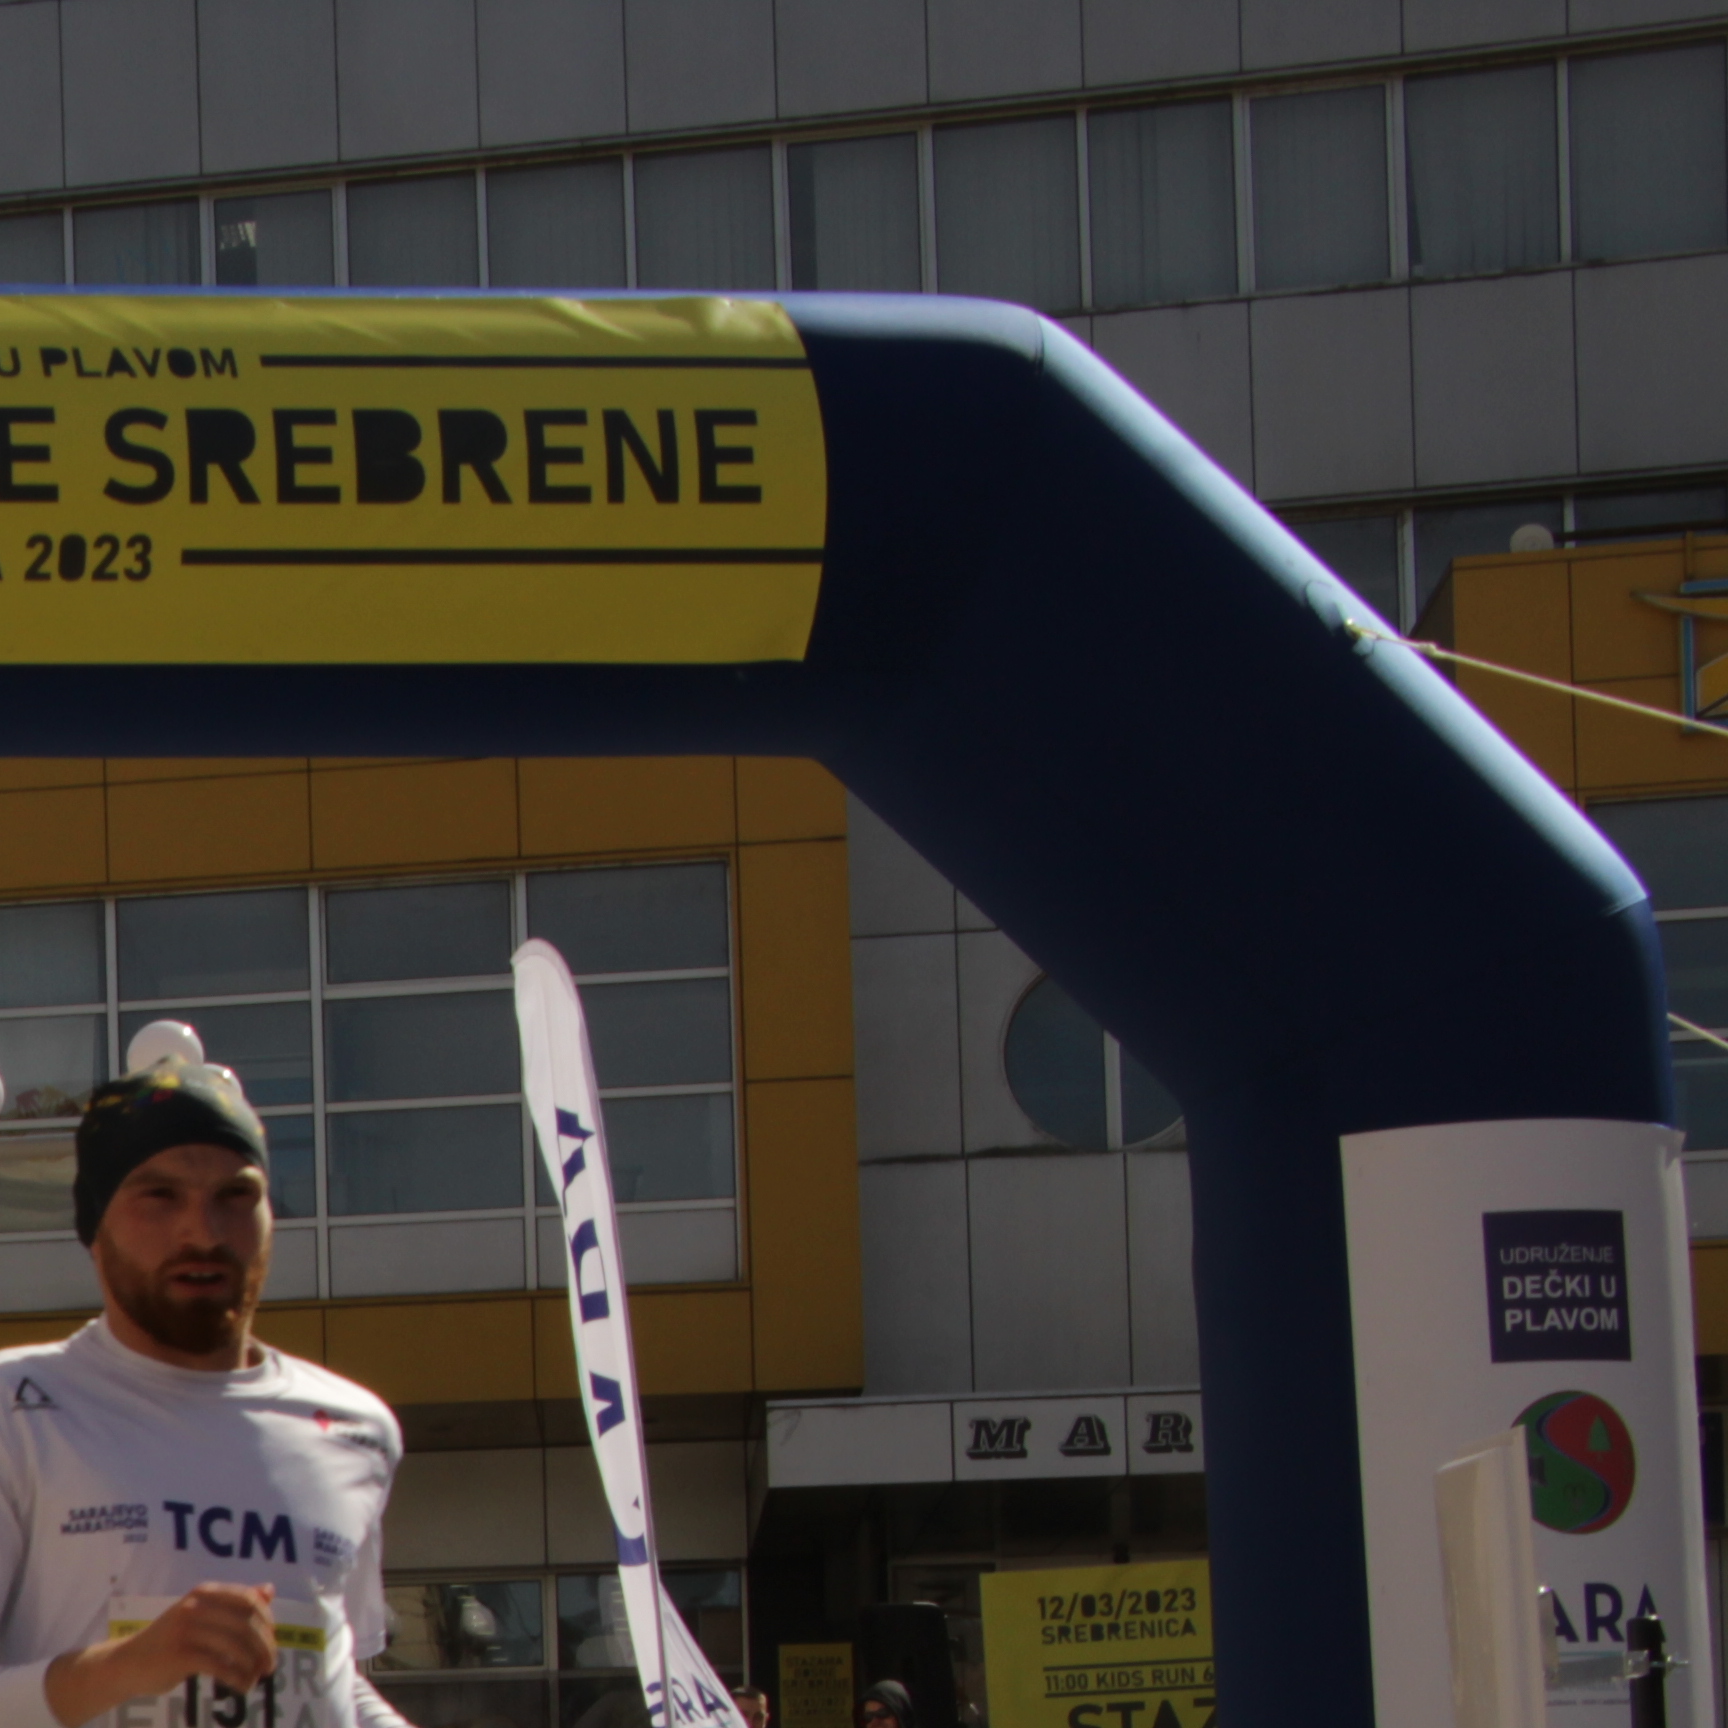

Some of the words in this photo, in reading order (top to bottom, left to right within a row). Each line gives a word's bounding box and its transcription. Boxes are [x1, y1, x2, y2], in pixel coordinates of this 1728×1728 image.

[39, 346, 239, 379] PLAVOM
[102, 406, 762, 506] SREBRENE
[24, 533, 154, 583] 2023
[1499, 1241, 1615, 1265] UDRUŽENJE
[1503, 1268, 1590, 1299] DEČKI
[1600, 1275, 1617, 1298] U
[1504, 1306, 1620, 1332] PLAVOM
[162, 1499, 298, 1564] TCM
[1037, 1587, 1197, 1622] 12/03/2023
[1041, 1617, 1197, 1645] SREBRENICA
[1045, 1672, 1089, 1692] 11:00
[1096, 1669, 1144, 1689] KIDS
[1151, 1666, 1195, 1686] RUN
